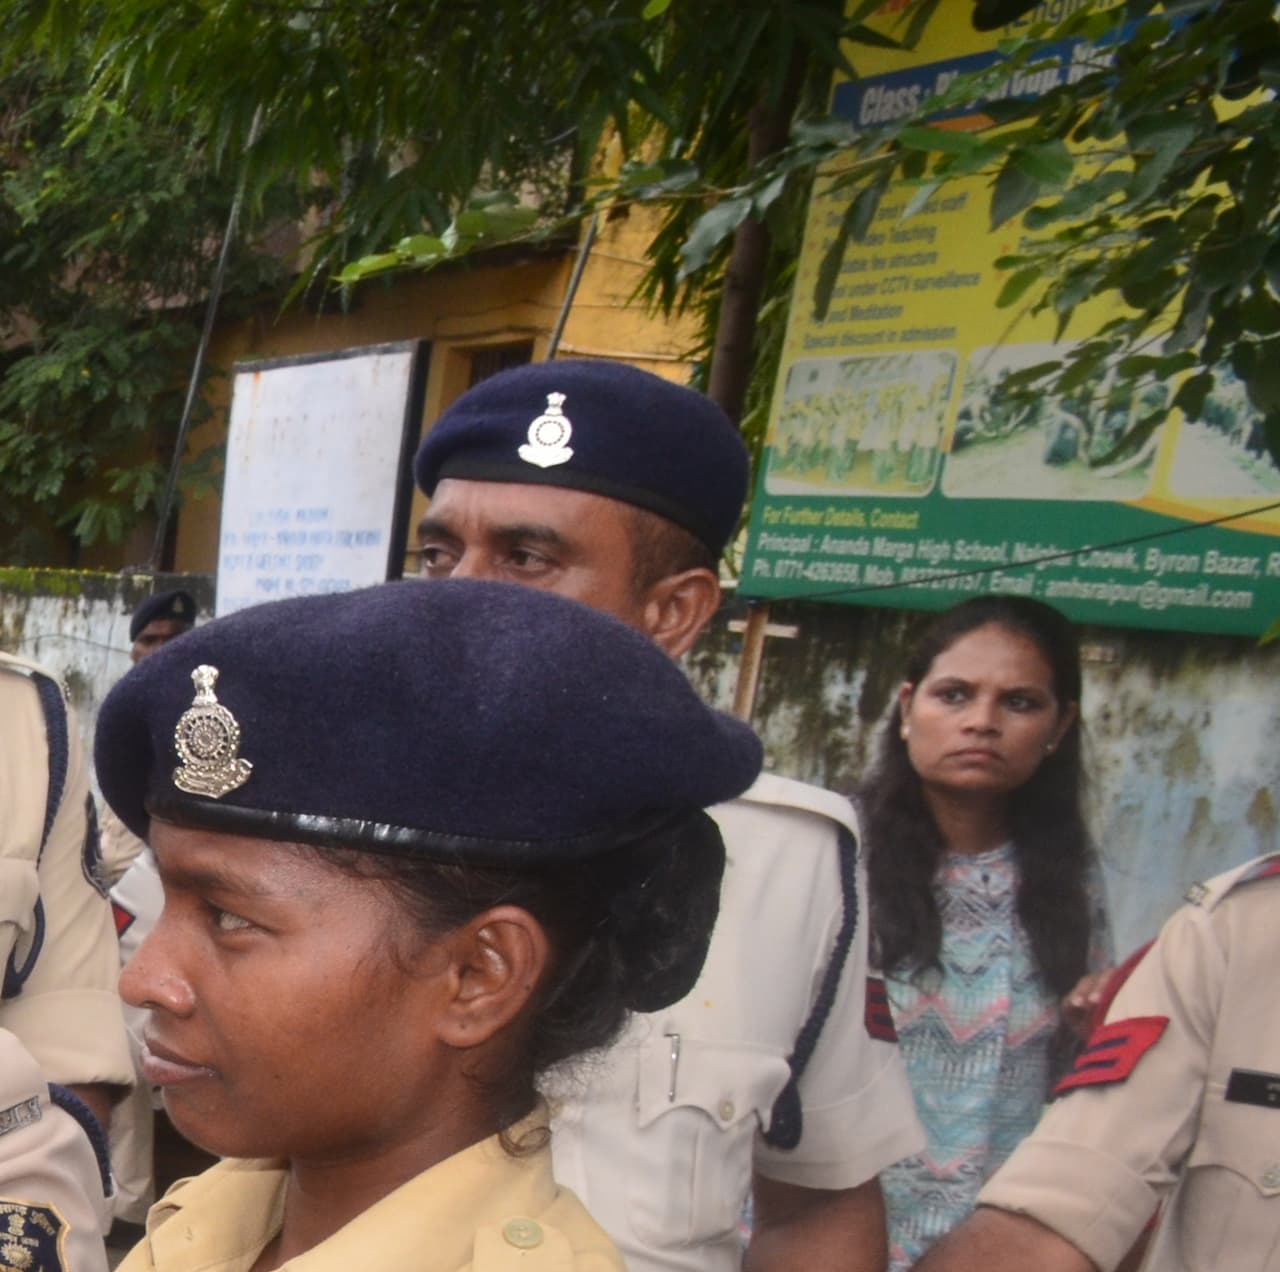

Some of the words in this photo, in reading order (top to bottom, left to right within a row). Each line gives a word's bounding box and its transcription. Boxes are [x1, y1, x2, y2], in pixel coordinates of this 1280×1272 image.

[870, 509, 920, 530] Contact
[917, 538, 951, 565] High
[1144, 547, 1200, 576] Byron
[990, 571, 1034, 594] Email
